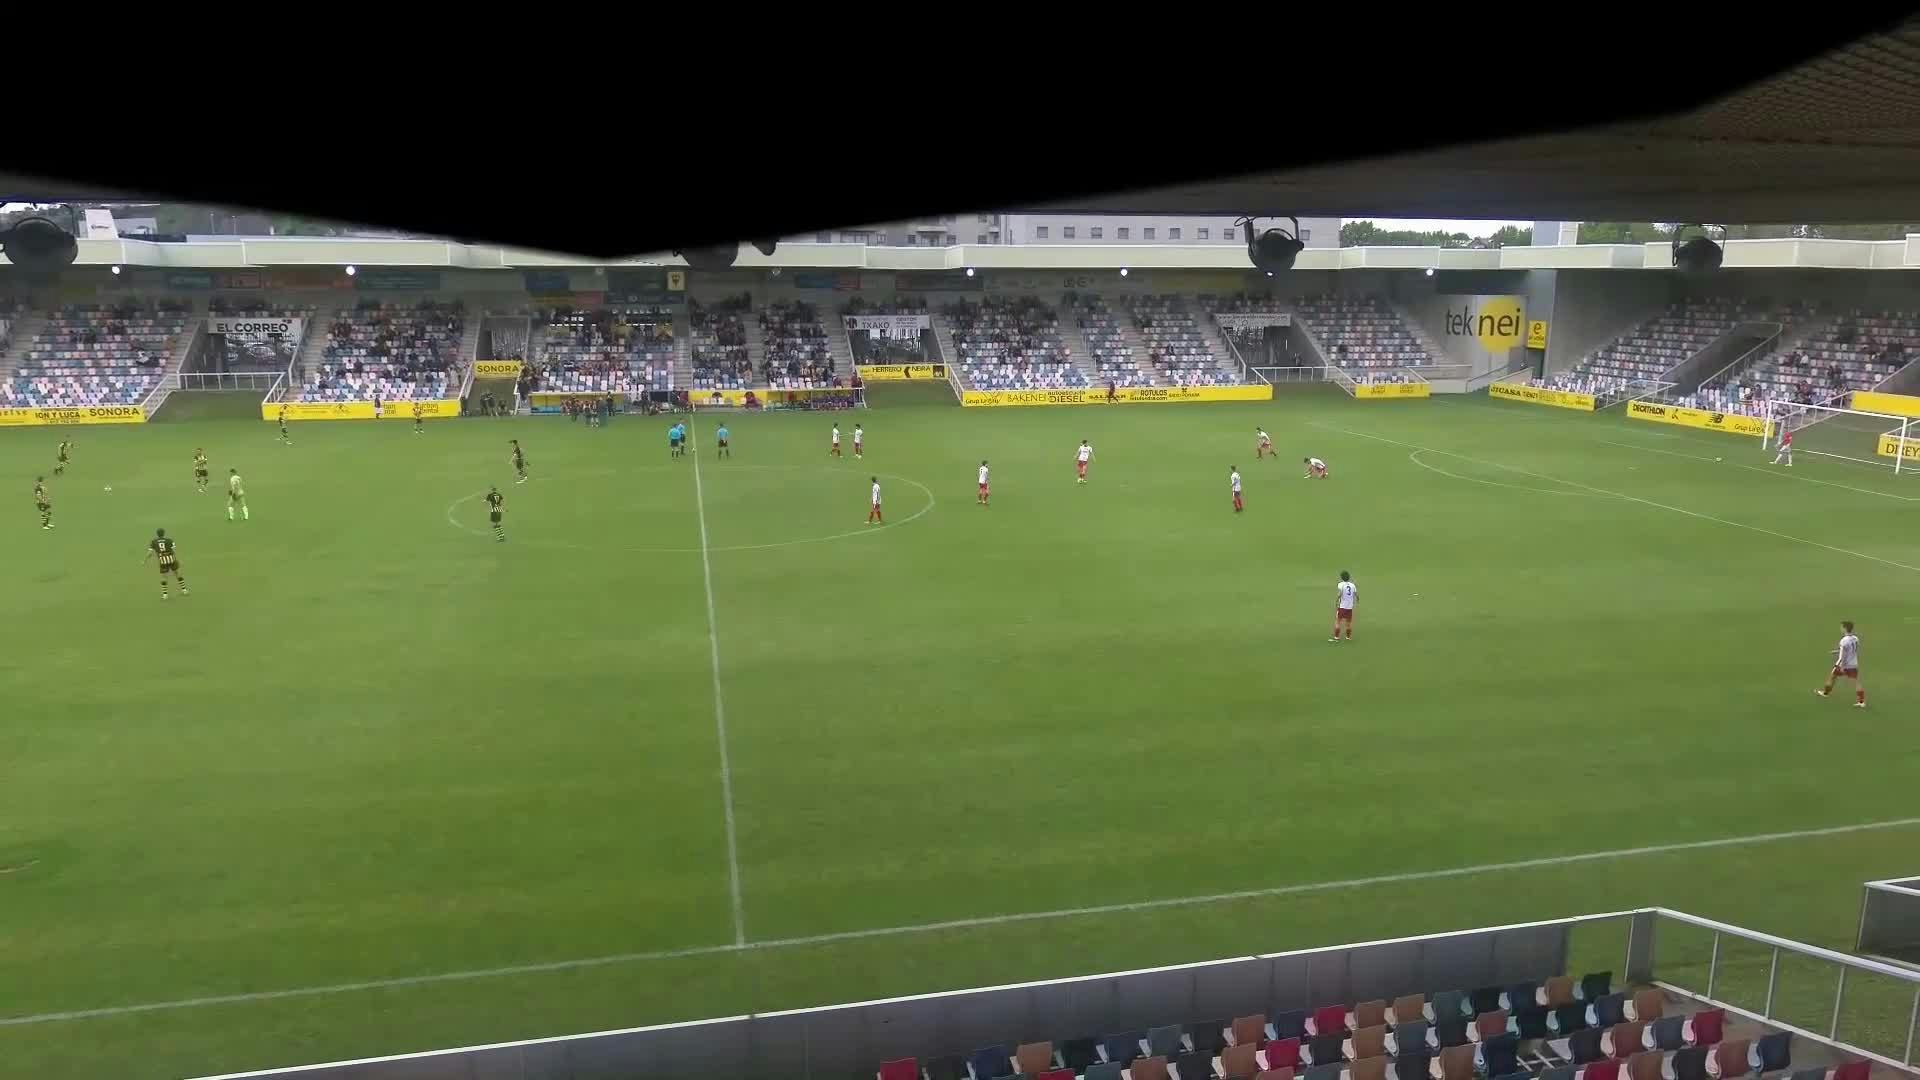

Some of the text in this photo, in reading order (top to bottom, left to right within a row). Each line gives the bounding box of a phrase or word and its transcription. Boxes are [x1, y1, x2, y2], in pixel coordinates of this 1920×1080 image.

[216, 323, 289, 333] EL CORREO
[477, 365, 519, 373] SONORA
[89, 407, 140, 417] SONORA
[1632, 404, 1666, 416] DECATHLON
[1346, 585, 1352, 596] 3
